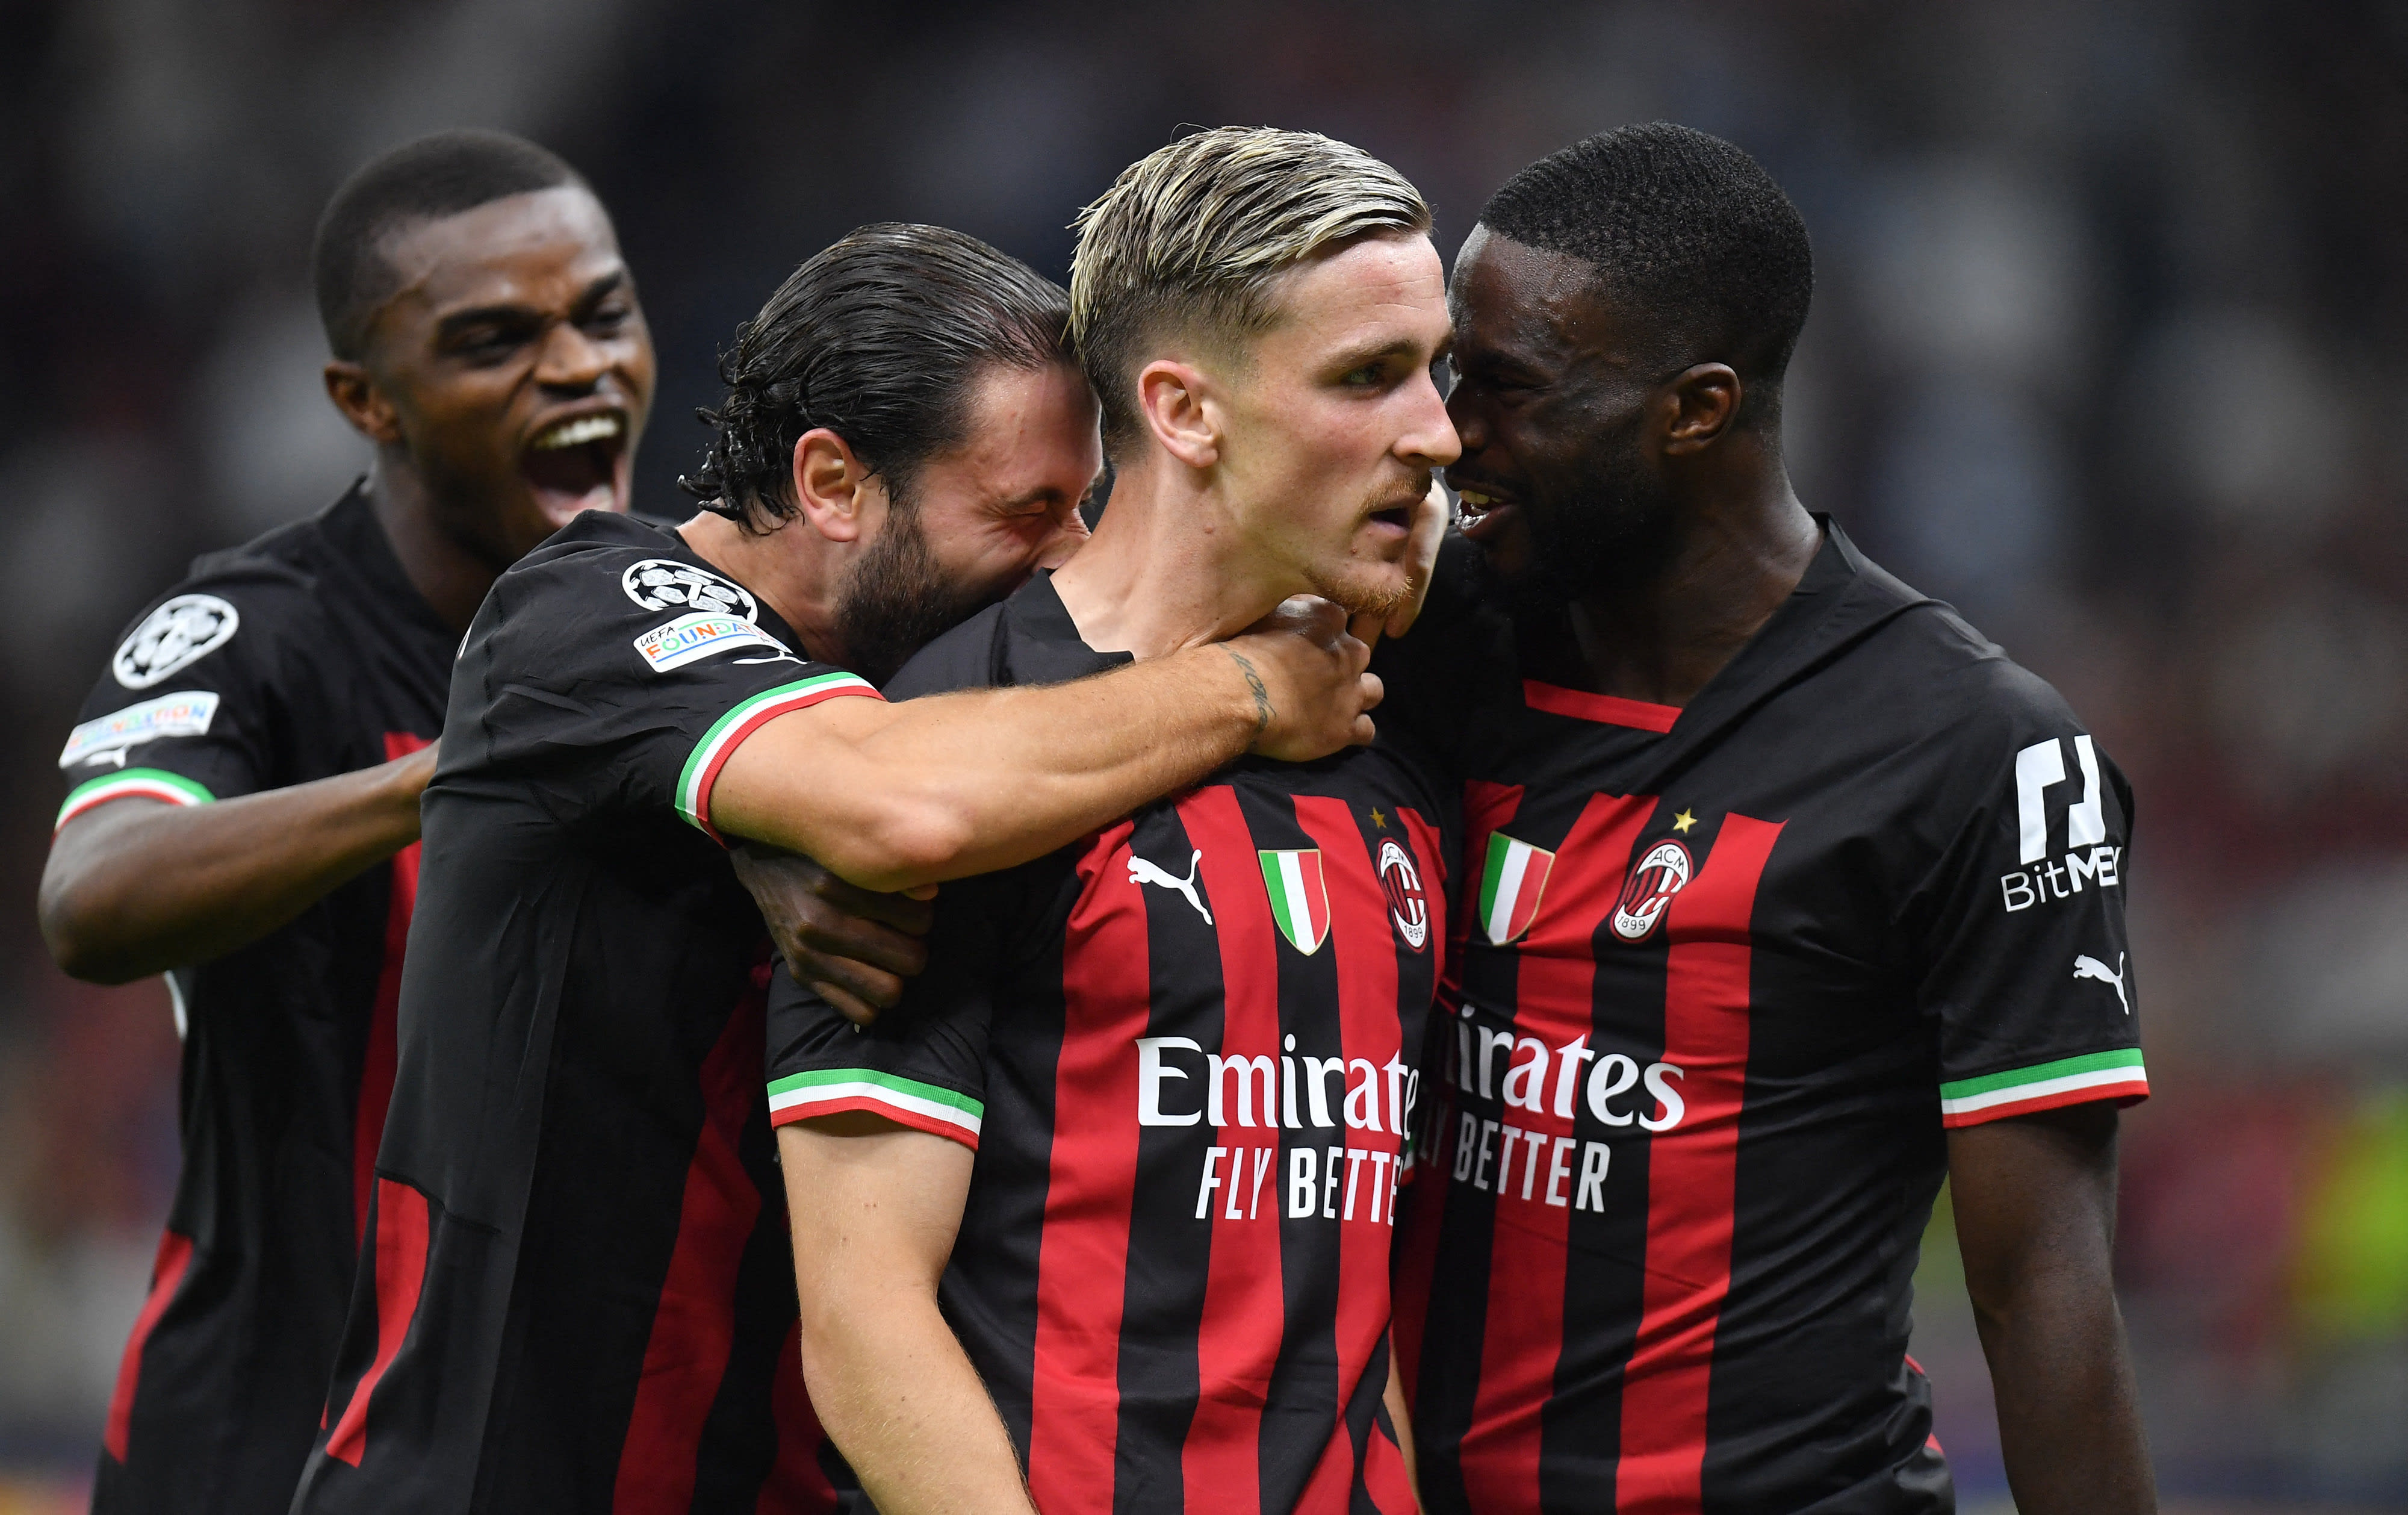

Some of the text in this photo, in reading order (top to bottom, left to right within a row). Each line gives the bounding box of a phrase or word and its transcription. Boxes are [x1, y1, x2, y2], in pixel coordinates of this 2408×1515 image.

[641, 626, 675, 647] UEFA
[646, 622, 783, 659] FOUNDAT
[1648, 848, 1684, 874] ACM
[1404, 924, 1423, 939] 1899
[1616, 915, 1646, 930] 1899
[1457, 1003, 1685, 1131] irates
[1135, 1033, 1420, 1140] Emirate
[1453, 1111, 1611, 1213] BETTER
[1195, 1145, 1403, 1226] FLY BETTE
